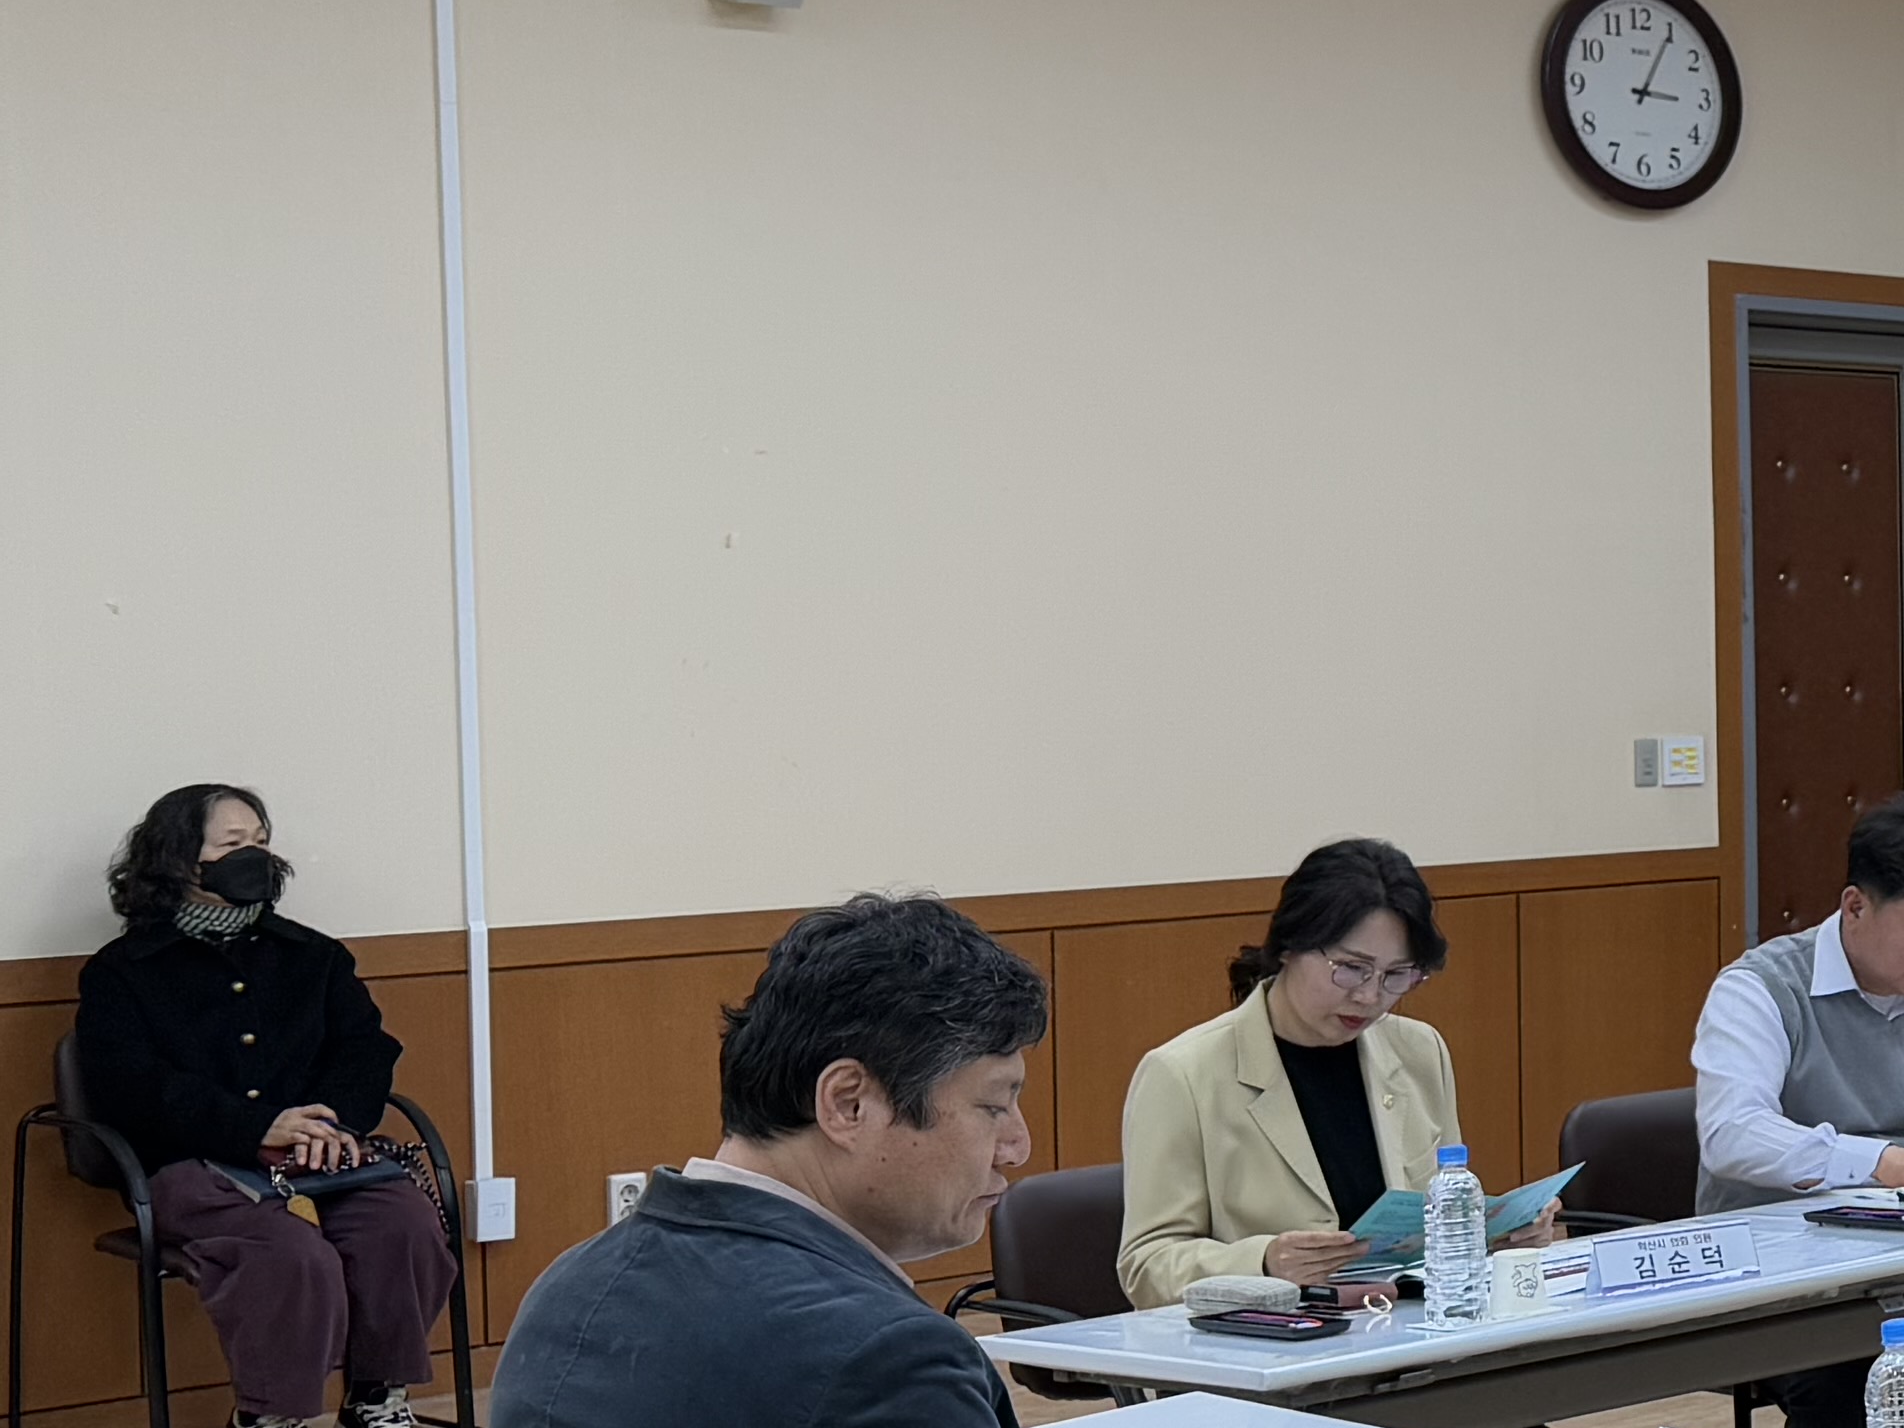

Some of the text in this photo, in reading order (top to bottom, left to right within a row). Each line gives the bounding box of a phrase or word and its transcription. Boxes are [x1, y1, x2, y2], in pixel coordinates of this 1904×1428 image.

[1604, 12, 1623, 36] 11
[1629, 7, 1652, 31] 12
[1666, 22, 1674, 43] 1
[1581, 38, 1604, 63] 10
[1688, 49, 1700, 72] 2
[1570, 72, 1586, 96] 9
[1698, 88, 1711, 111] 3
[1581, 111, 1596, 135] 8
[1688, 124, 1701, 145] 4
[1608, 141, 1621, 165] 7
[1668, 147, 1681, 170] 5
[1637, 154, 1651, 177] 6
